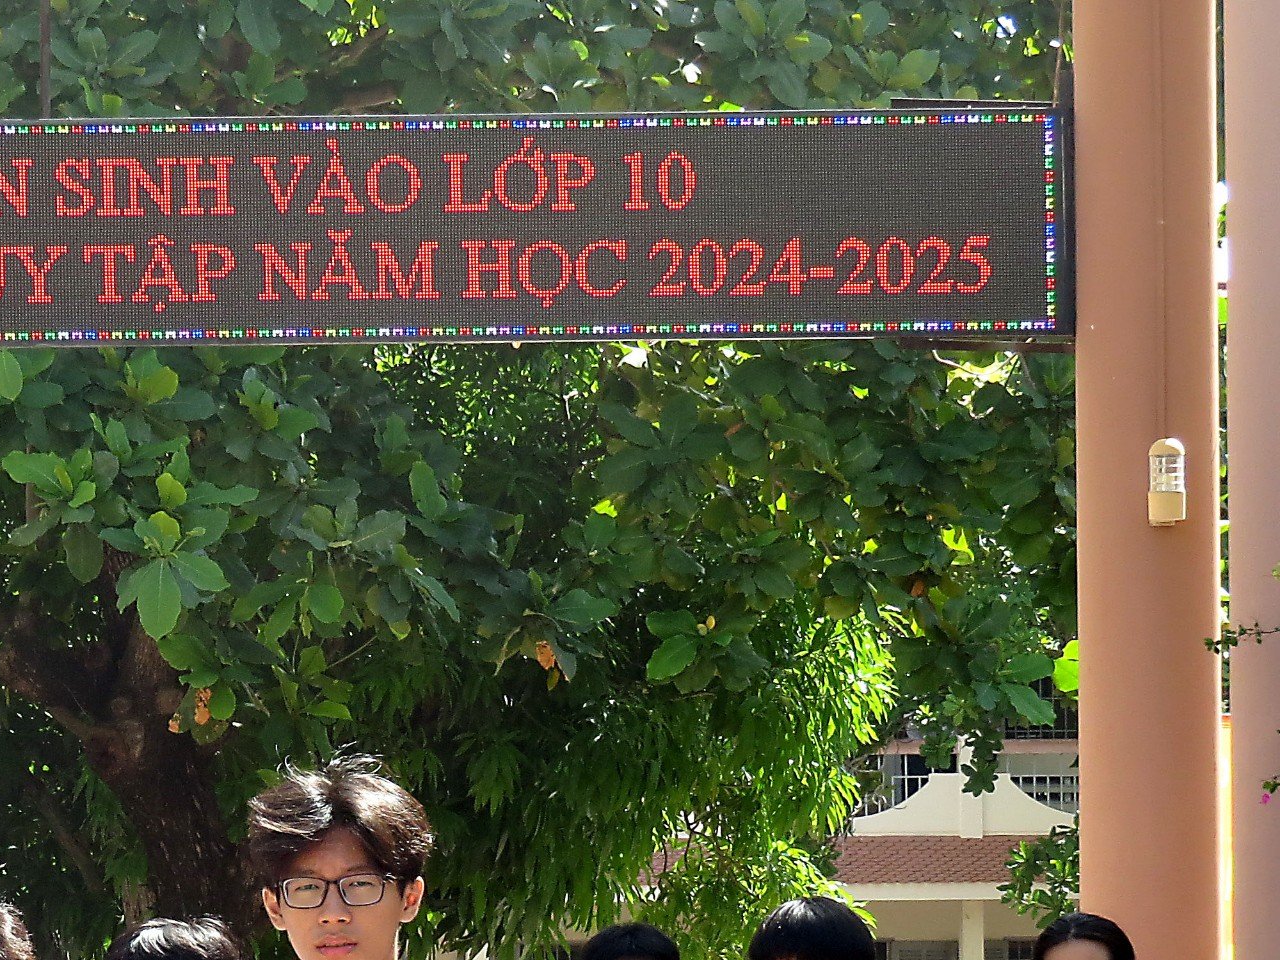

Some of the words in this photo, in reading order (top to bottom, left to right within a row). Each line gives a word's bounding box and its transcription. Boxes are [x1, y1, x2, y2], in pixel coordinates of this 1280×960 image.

[54, 156, 236, 217] SINH
[253, 139, 423, 215] VÀO
[442, 138, 596, 213] LỚP
[622, 152, 697, 211] 10
[82, 235, 236, 312] TẬP
[255, 230, 441, 301] NĂM
[462, 239, 628, 308] HỌC
[649, 236, 992, 297] 2024-2025
